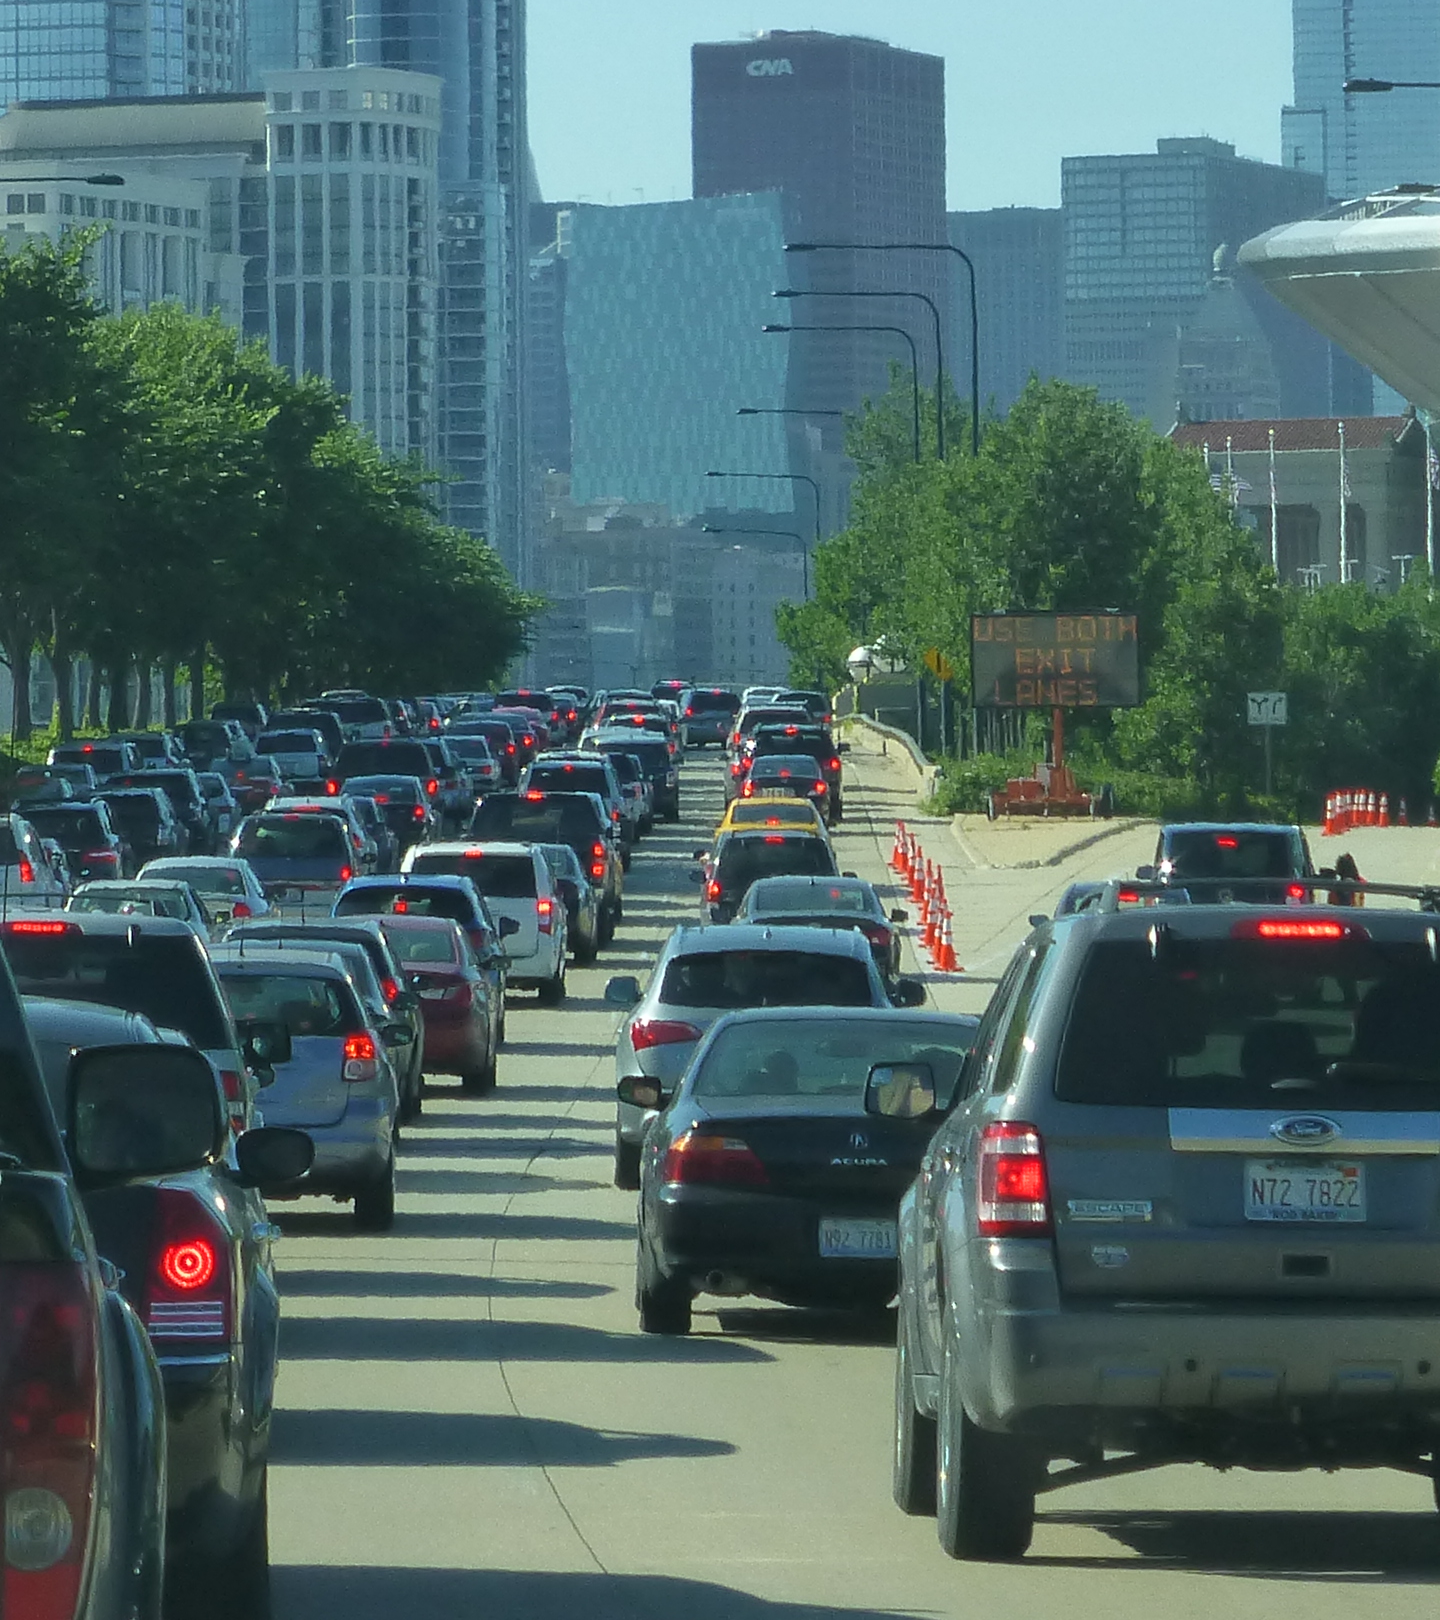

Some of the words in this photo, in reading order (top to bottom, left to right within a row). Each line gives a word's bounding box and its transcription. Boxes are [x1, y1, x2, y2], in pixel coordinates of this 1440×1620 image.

[746, 58, 793, 77] CNA
[973, 616, 1034, 642] USE
[1057, 616, 1137, 641] BOTH
[1016, 648, 1096, 674] EXIT
[995, 679, 1098, 706] LANES
[830, 1157, 888, 1166] ACURA
[1252, 1178, 1292, 1207] N72
[1307, 1179, 1360, 1208] 7822
